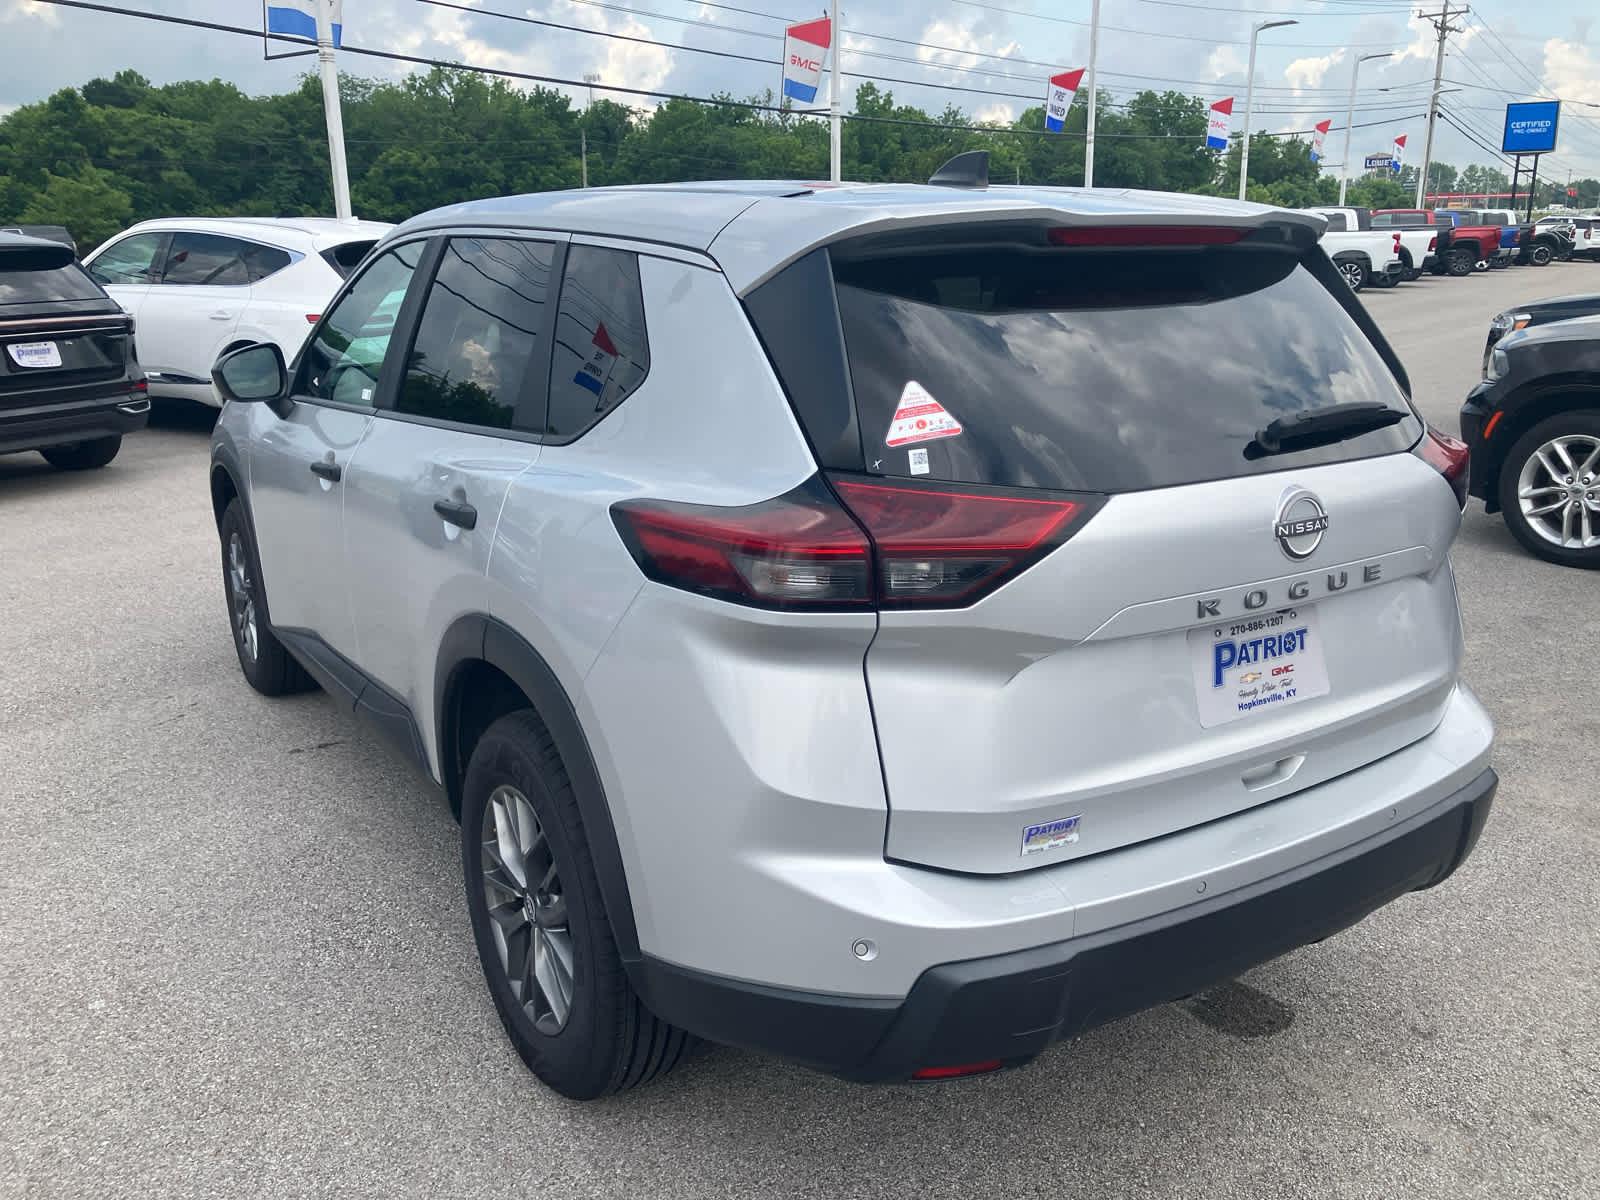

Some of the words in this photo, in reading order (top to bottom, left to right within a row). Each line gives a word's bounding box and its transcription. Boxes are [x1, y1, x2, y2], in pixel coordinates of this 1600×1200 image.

[790, 54, 820, 73] GMC
[1511, 120, 1551, 129] CERTIFIED
[1278, 517, 1328, 536] NISSAN
[1197, 564, 1381, 619] ROGUE
[1213, 627, 1308, 688] PATRIOT
[1271, 664, 1294, 676] GMC
[1238, 694, 1285, 711] Hopkinsville,
[1286, 688, 1297, 698] KY
[1025, 817, 1081, 843] PATRIOT
